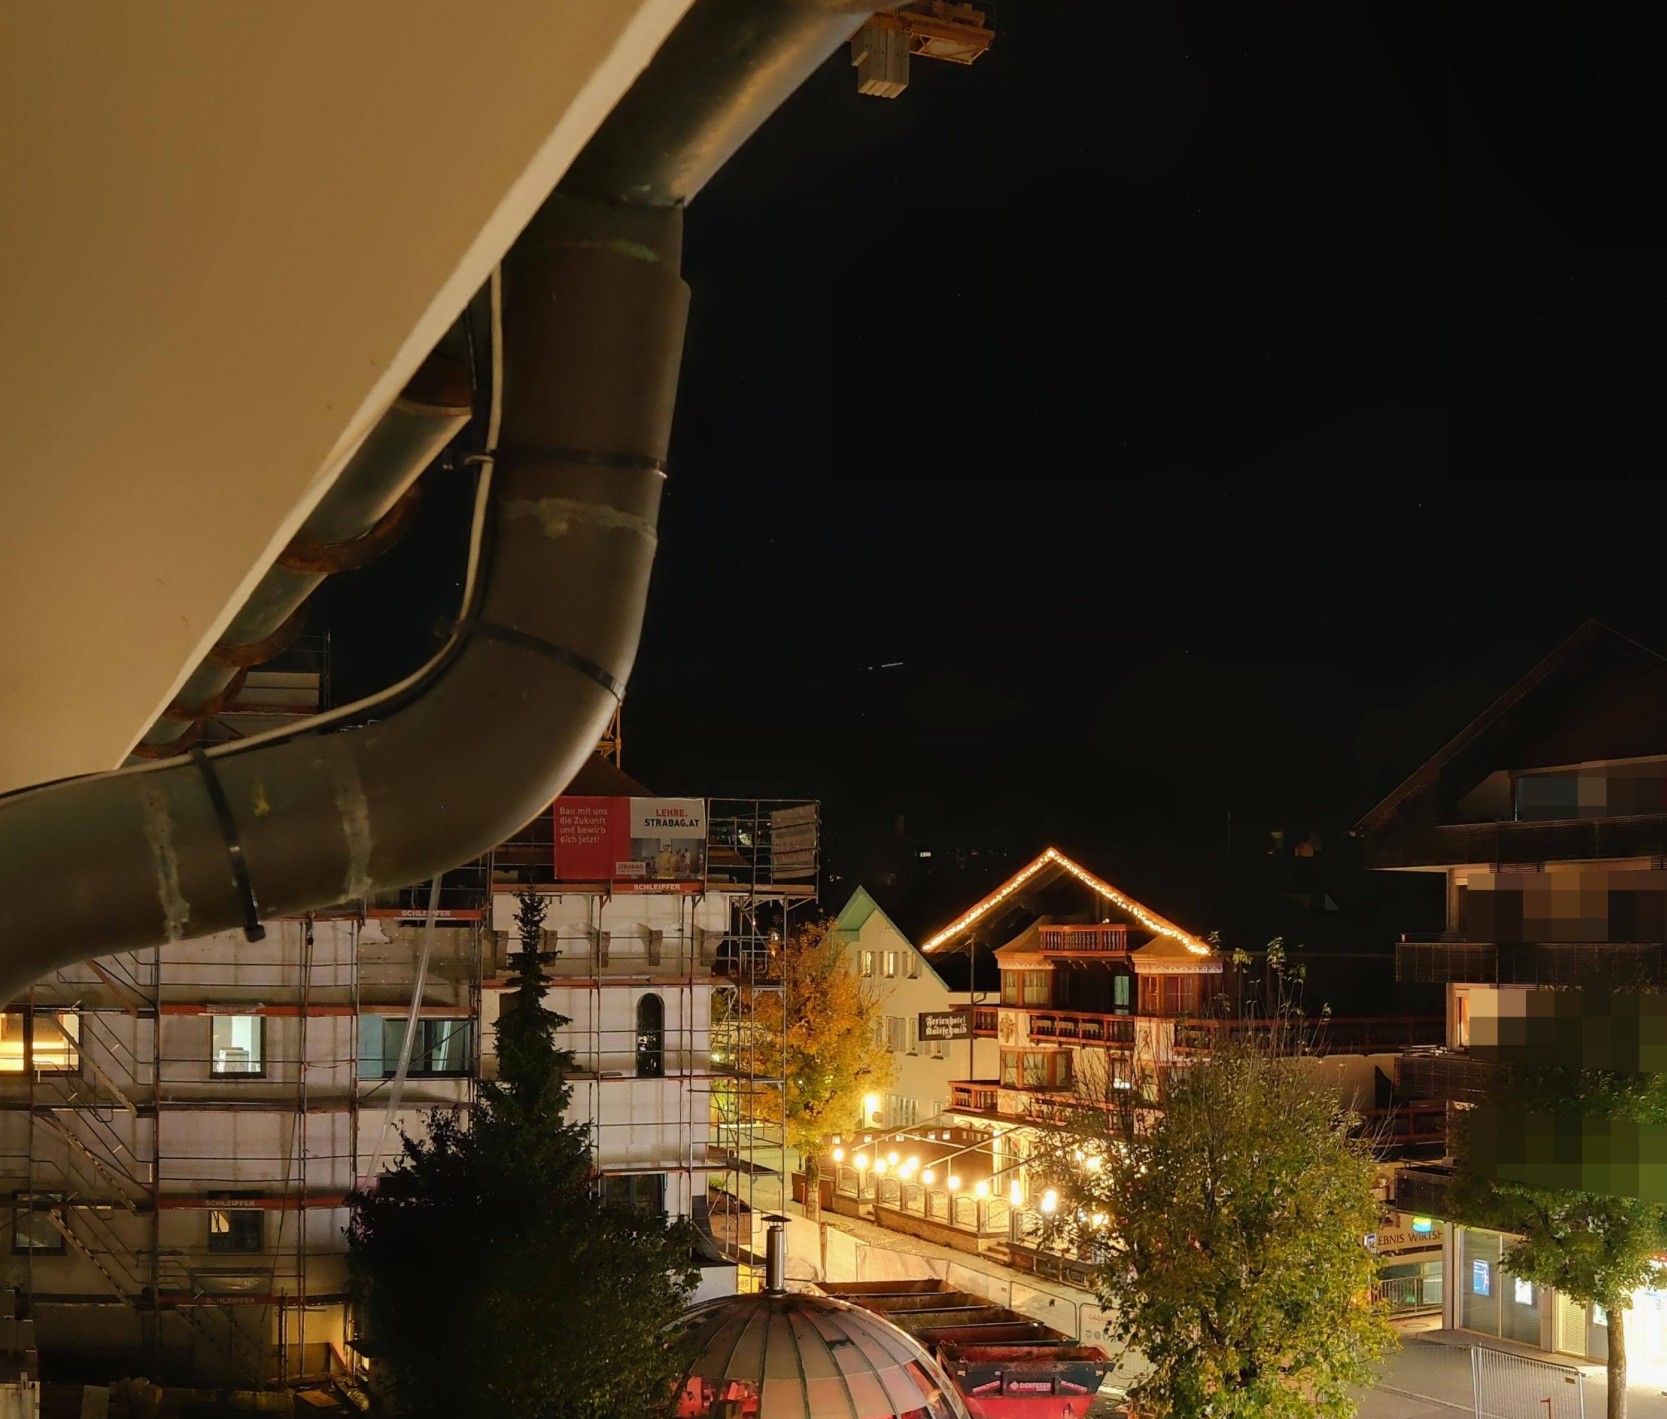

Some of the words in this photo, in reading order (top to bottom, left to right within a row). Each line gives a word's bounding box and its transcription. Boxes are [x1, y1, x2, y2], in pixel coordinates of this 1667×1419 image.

[559, 807, 576, 816] Bau
[577, 806, 592, 815] mit
[593, 808, 608, 816] uns
[656, 808, 687, 817] LEHRE.
[559, 816, 572, 825] die
[574, 815, 606, 825] Zukunft
[644, 818, 700, 827] STRABAG.AT
[559, 825, 575, 834] und
[577, 825, 606, 834] bewirb
[559, 834, 577, 844] dich
[578, 835, 600, 845] jetzt!
[633, 883, 681, 891] SCHLEIPFER
